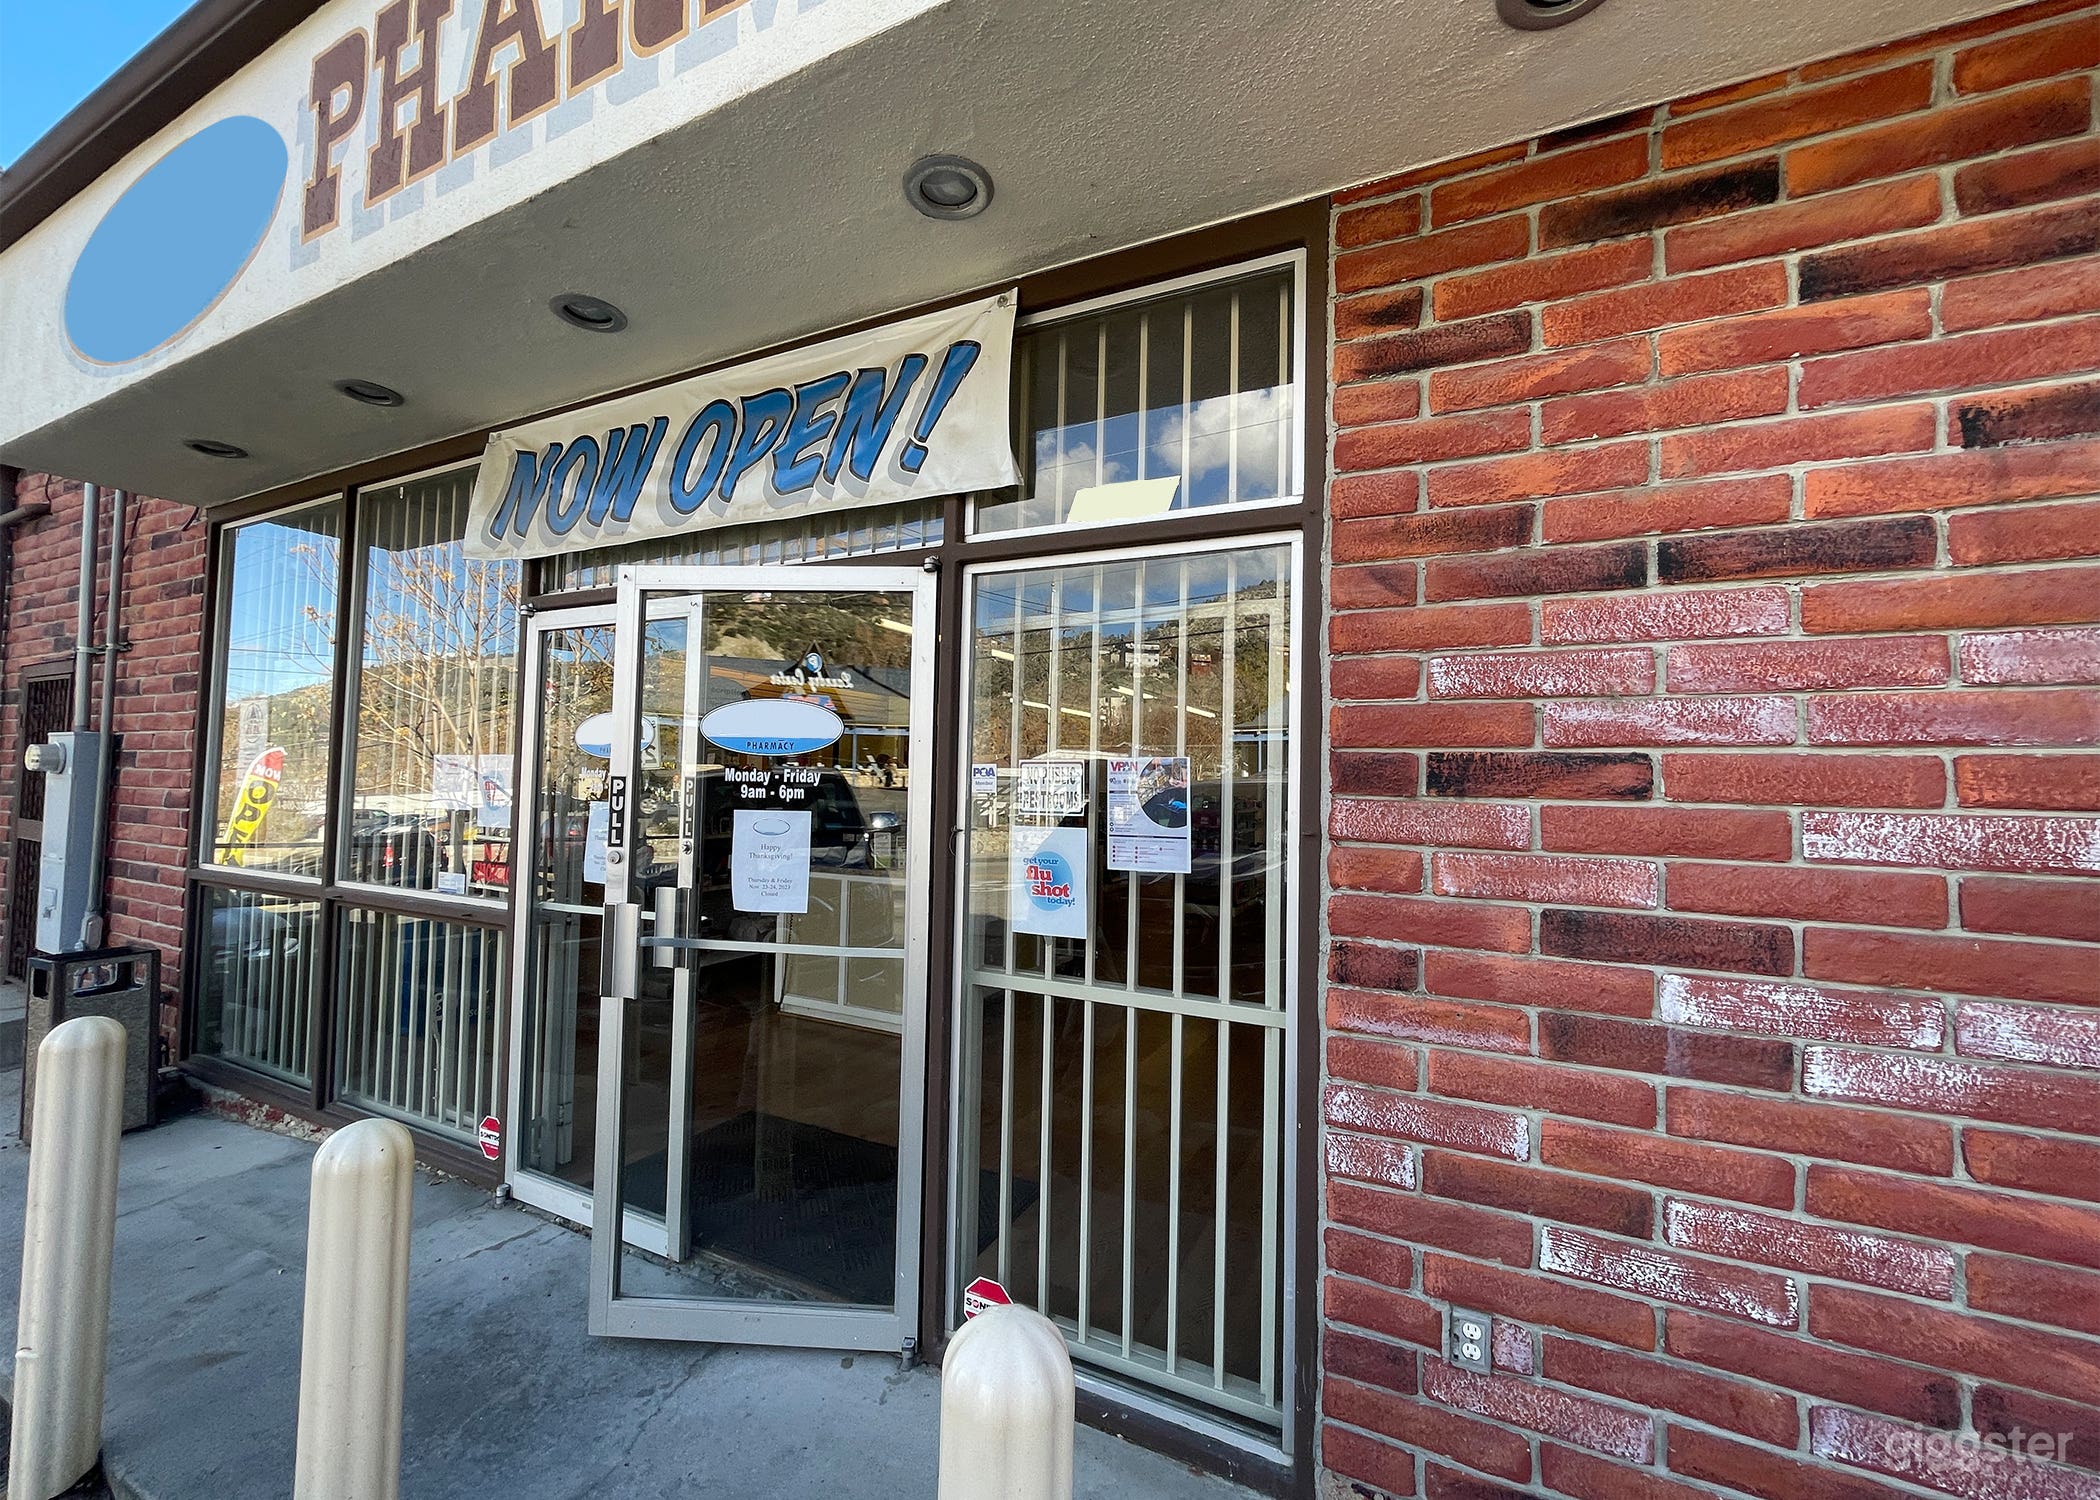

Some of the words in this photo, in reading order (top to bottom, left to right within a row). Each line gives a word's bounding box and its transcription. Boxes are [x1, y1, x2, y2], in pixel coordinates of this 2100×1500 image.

[489, 415, 670, 542] NOW
[668, 338, 984, 517] OPEN!
[746, 740, 795, 751] PHARMACY
[724, 767, 771, 785] Monday
[783, 769, 821, 786] Friday
[740, 784, 766, 799] 9am
[778, 784, 805, 803] 6pm
[1023, 790, 1080, 810] RESTROOMS
[610, 779, 625, 845] PULL
[684, 779, 694, 837] PULL
[749, 852, 793, 861] Thanksgiving!
[760, 843, 781, 853] Happy
[1023, 857, 1038, 866] get
[1038, 858, 1059, 867] your
[1026, 865, 1053, 882] flu
[1031, 880, 1070, 898] shot
[1047, 896, 1076, 908] today!
[965, 1297, 990, 1311] SON
